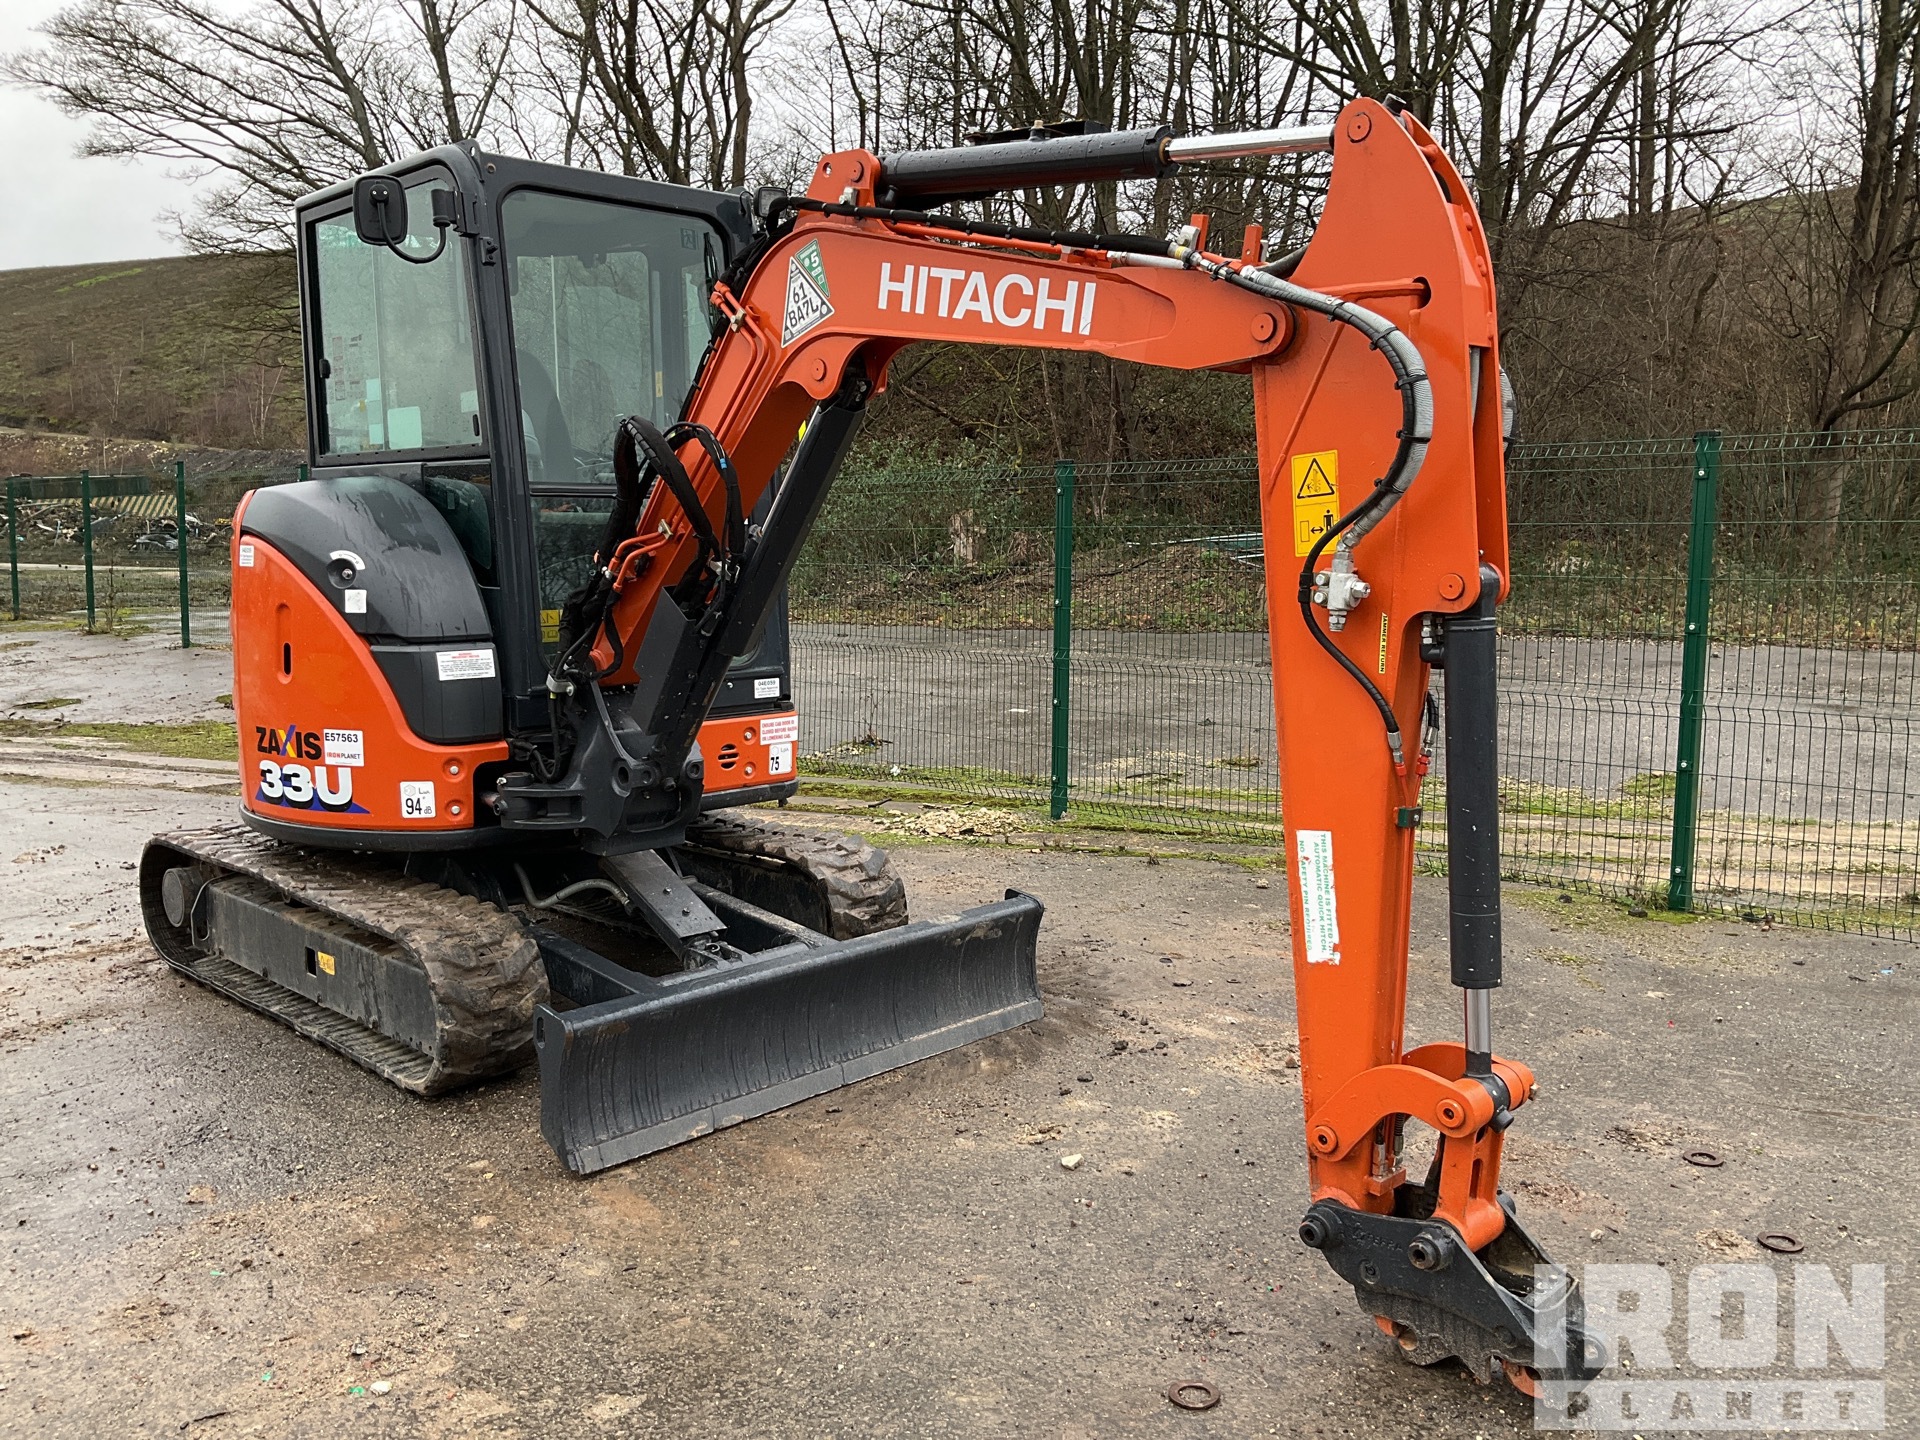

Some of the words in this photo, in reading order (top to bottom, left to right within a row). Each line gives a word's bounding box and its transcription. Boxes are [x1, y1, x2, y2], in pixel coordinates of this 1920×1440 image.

[810, 251, 820, 268] 5
[792, 282, 807, 304] 61
[878, 262, 1096, 336] HITACHI
[788, 297, 818, 328] BA7L
[256, 724, 322, 760] ZAXIS
[324, 732, 358, 743] E57563
[770, 756, 779, 771] 75
[260, 760, 353, 810] 33U
[405, 798, 422, 815] 94
[1299, 840, 1305, 852] NO
[1314, 842, 1322, 892] AUTOMATIC
[1325, 898, 1331, 906] IS
